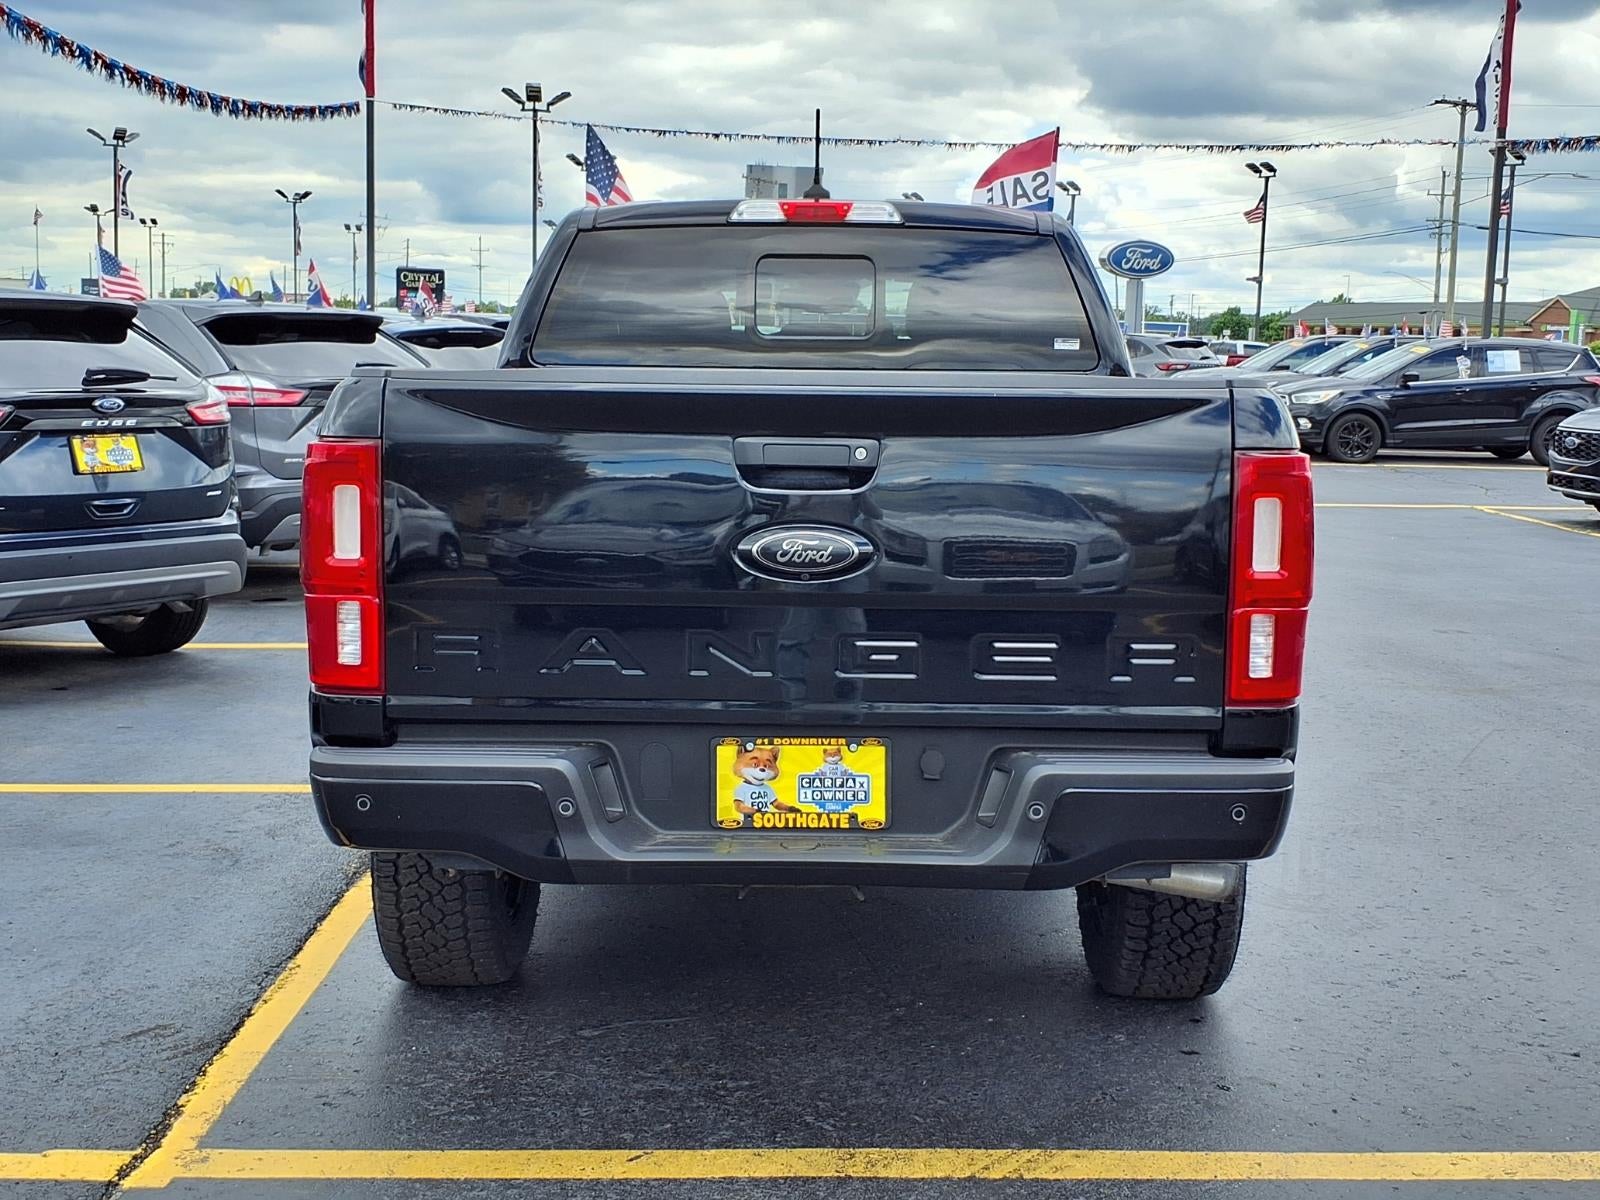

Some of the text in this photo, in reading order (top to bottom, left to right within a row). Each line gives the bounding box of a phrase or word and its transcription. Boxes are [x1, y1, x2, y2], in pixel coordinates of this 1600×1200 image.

[1121, 247, 1162, 270] Ford
[776, 538, 833, 563] Ford
[412, 628, 1199, 683] RANGER
[801, 777, 866, 789] CARFAX
[750, 791, 769, 800] CAR
[803, 790, 867, 801] 1 OWNER
[750, 801, 769, 810] FOX
[753, 813, 849, 828] SOUTHGATE
